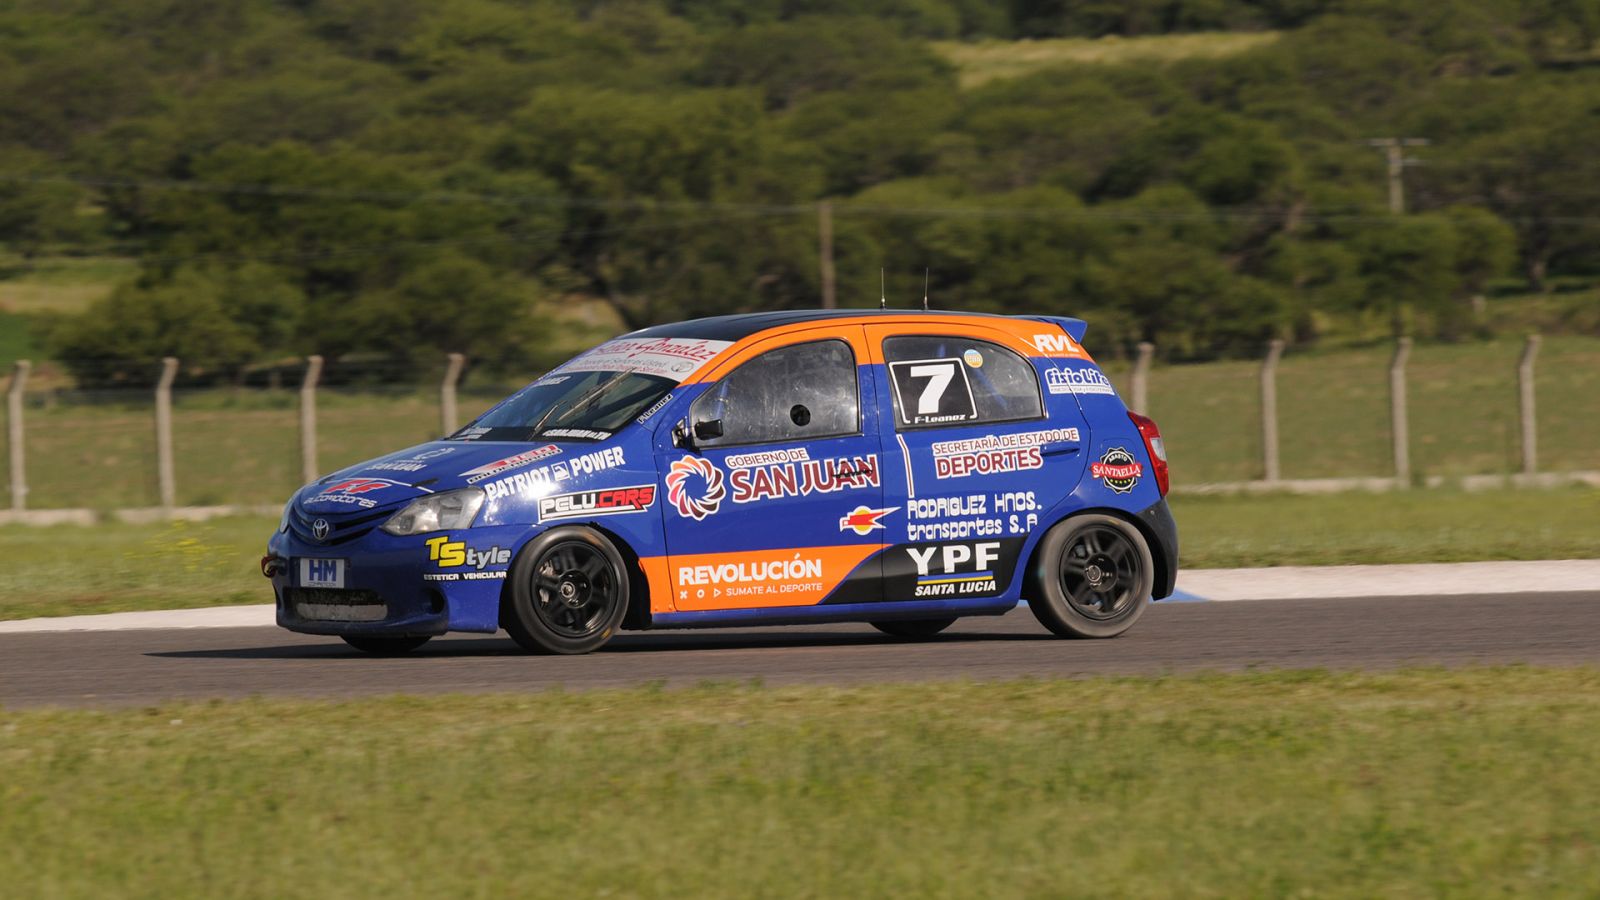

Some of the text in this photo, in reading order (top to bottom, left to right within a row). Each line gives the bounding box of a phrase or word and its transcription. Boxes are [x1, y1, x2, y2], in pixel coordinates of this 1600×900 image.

[1033, 334, 1079, 353] RVL
[910, 364, 955, 414] 7
[933, 429, 1078, 454] SECRETARÍA DE ESTADO DE
[727, 449, 807, 467] GOBIERNO DE
[937, 447, 1041, 477] DEPORTES
[1093, 464, 1141, 477] SANTAELLA
[484, 465, 550, 501] PATRIOT
[569, 446, 626, 477] POWER
[733, 456, 878, 501] SAN JUAN
[541, 487, 655, 515] PELU.CARS
[907, 494, 987, 519] RODRIGUEZ
[907, 517, 1003, 541] transportes
[425, 536, 512, 570] TStyle
[906, 541, 1001, 576] YPF
[309, 559, 337, 581] HM
[424, 571, 507, 581] ESTETICA VEHICULAR
[679, 552, 822, 585] REVOLUCIÓN
[726, 582, 823, 597] SUMATE AL DEPORTE
[915, 580, 997, 597] SANTA LUCIA
